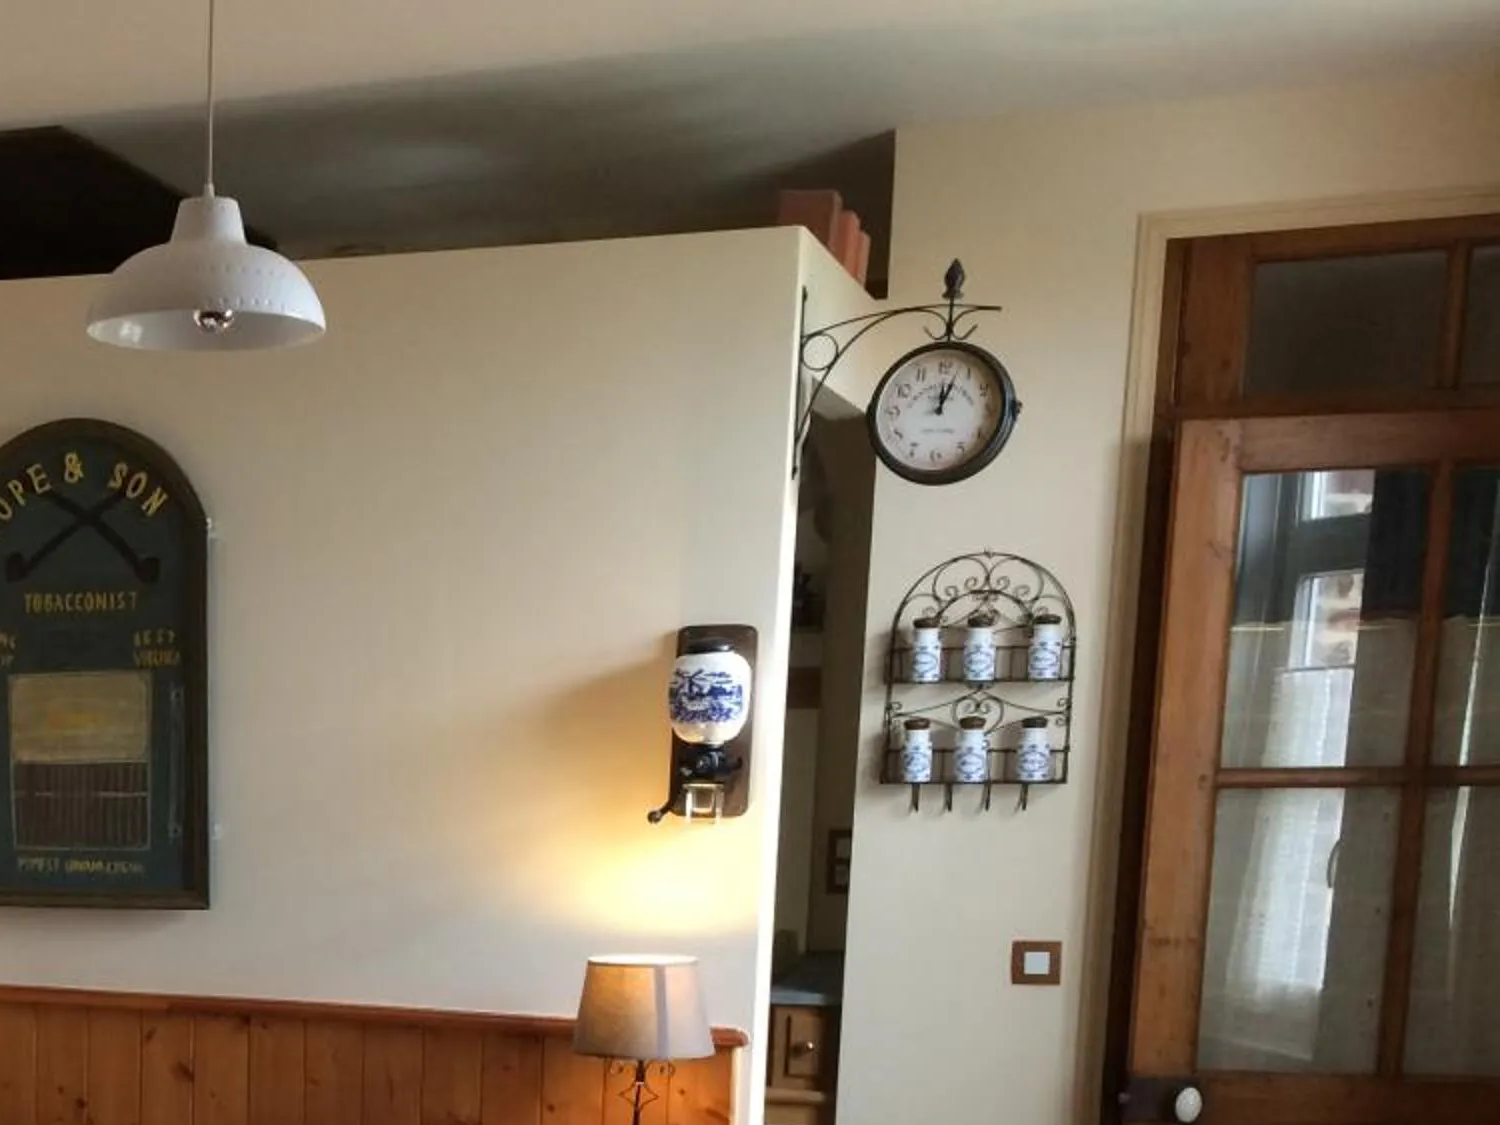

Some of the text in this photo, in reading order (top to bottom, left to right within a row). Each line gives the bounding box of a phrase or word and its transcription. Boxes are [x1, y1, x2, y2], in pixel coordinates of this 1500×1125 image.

[64, 451, 84, 483] &
[108, 463, 170, 517] SON
[24, 591, 138, 613] TOBACCONIST
